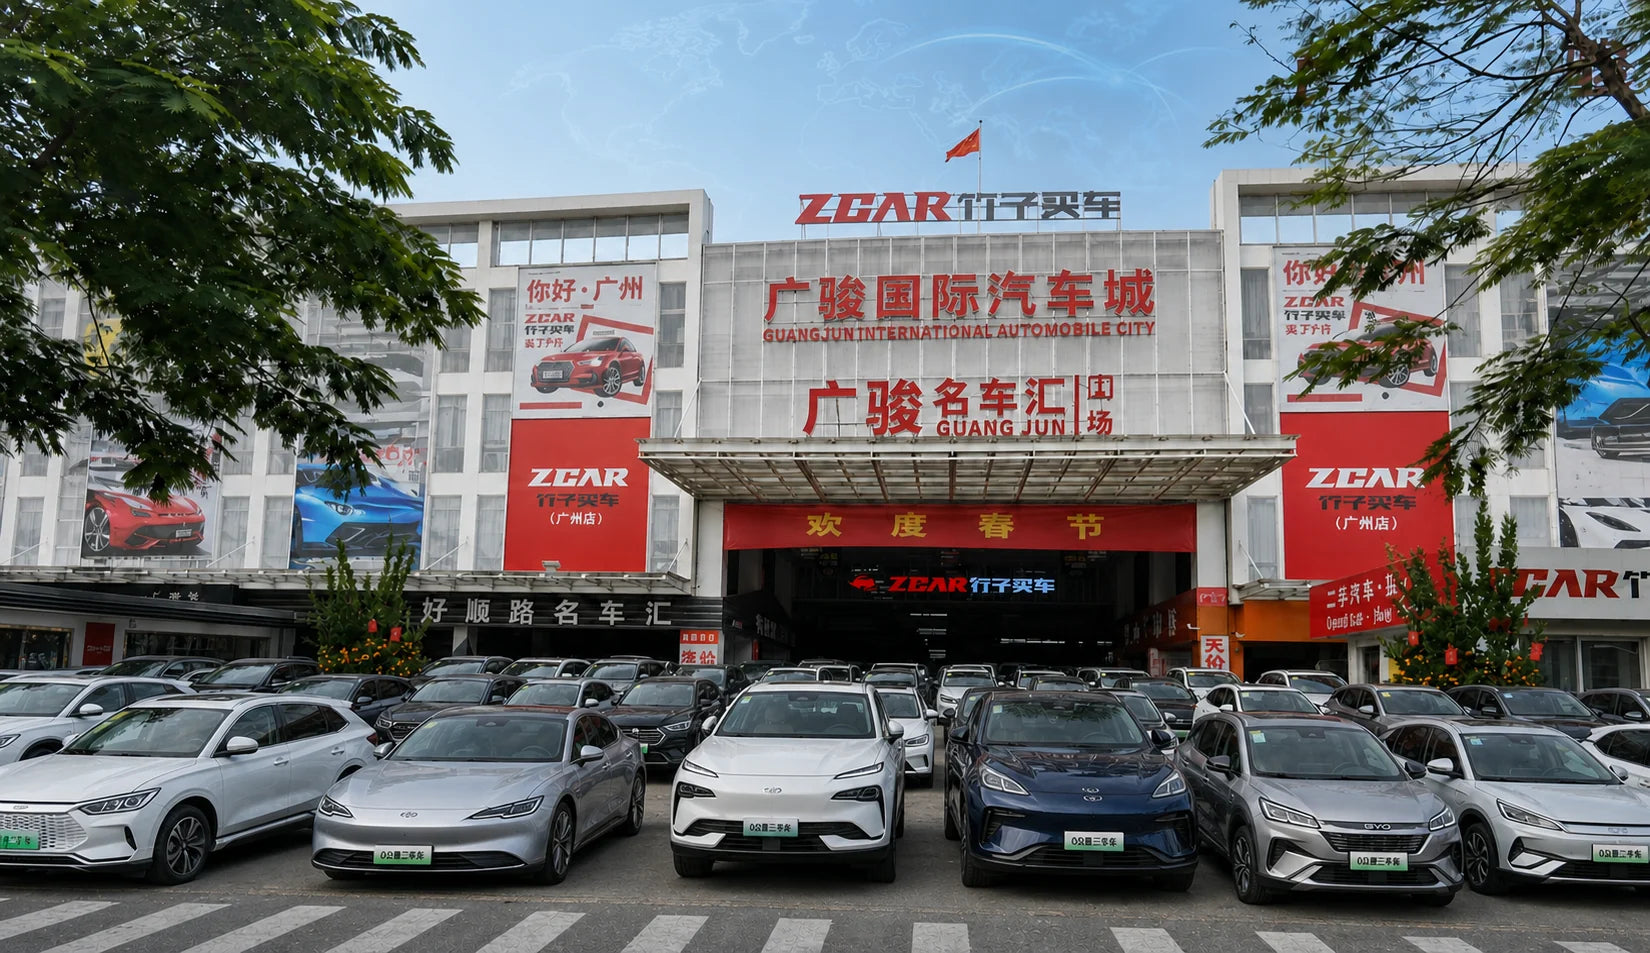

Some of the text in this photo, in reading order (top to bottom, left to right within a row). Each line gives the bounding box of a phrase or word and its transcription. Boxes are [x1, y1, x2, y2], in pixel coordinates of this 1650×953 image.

[957, 190, 1120, 221] 竹子买车
[527, 275, 643, 303] 你好·广州
[764, 268, 1156, 324] 广骏国际汽车城
[763, 320, 1156, 343] GUANGJUN INTERNATIONAL AUTOMOBILE CITY
[802, 378, 1066, 437] 广骏名车汇
[936, 418, 1066, 437] GUANG JUN
[806, 512, 1105, 540] 欢度春节
[420, 597, 672, 626] 好顺路名车汇
